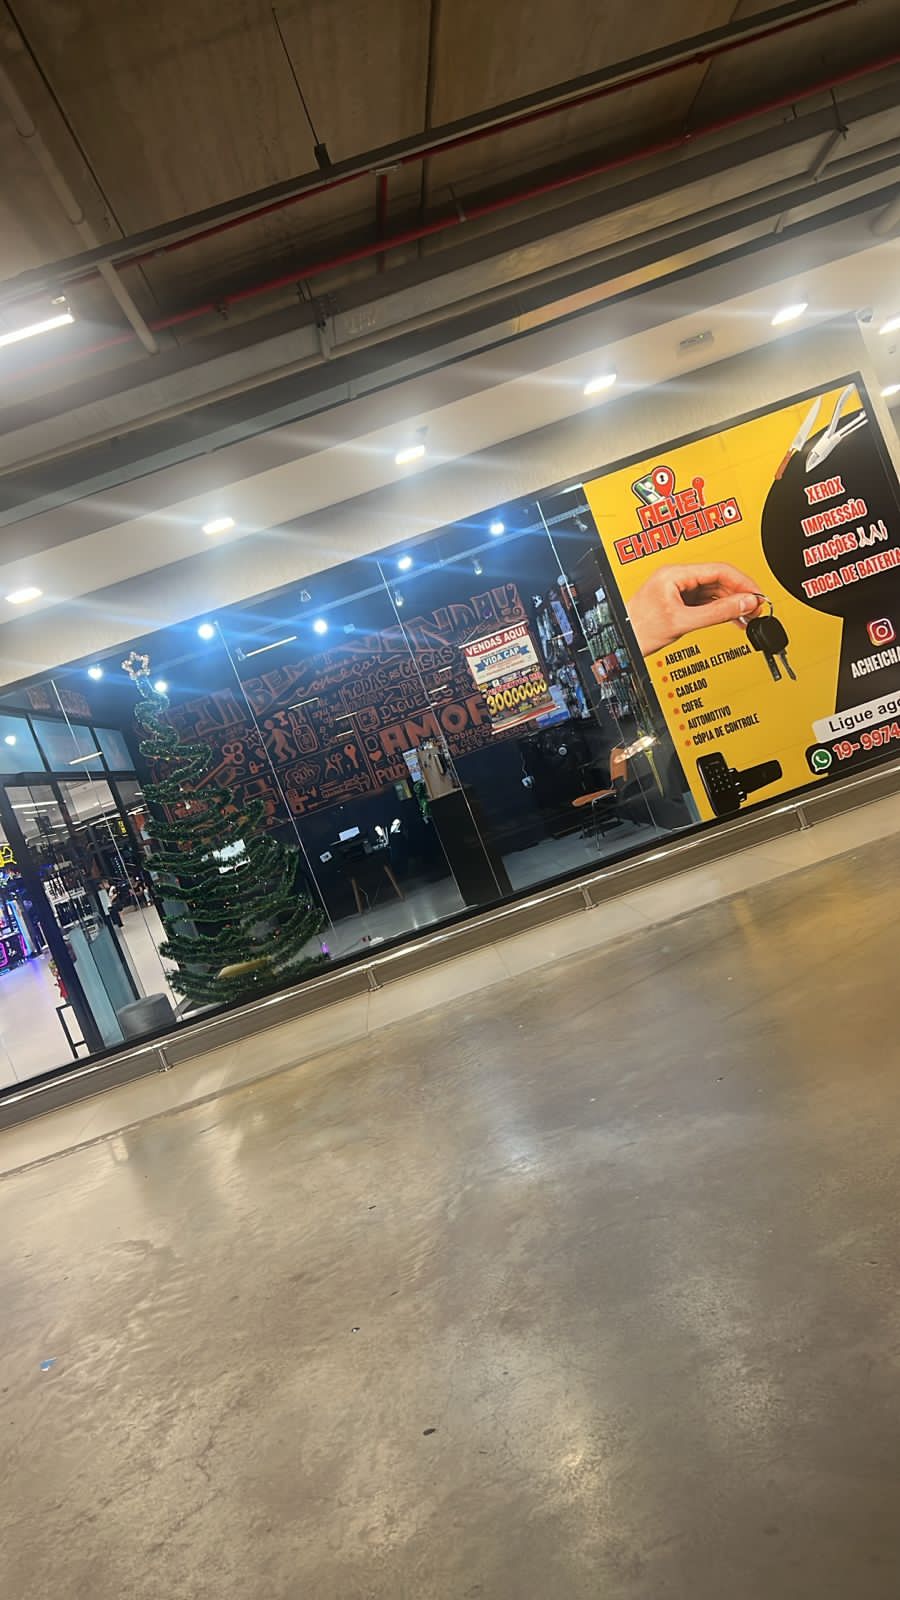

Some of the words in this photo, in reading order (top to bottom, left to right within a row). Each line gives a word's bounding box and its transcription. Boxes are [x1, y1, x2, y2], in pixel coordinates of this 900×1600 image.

[804, 476, 845, 505] XEROX
[613, 497, 742, 565] CHAVEIRO
[801, 499, 868, 537] IMPRESSÃO
[803, 532, 858, 567] AFIAÇÕES
[802, 571, 842, 598] TROCA
[840, 564, 859, 585] DE
[466, 636, 502, 656] VENDAS
[504, 627, 526, 642] AQUI
[665, 644, 701, 666] ABERTURA
[483, 654, 503, 667] VIDA
[503, 647, 520, 658] CAP
[670, 659, 710, 682] FECHADURA
[710, 644, 752, 667] ELETRÔNICA
[676, 678, 708, 698] CADEADO
[681, 698, 704, 714] COFRE
[688, 705, 731, 730] AUTOMOTIVO
[692, 730, 715, 746] CÓPIA
[714, 726, 725, 738] DE
[724, 713, 760, 734] CONTROLE
[829, 710, 873, 732] Ligue
